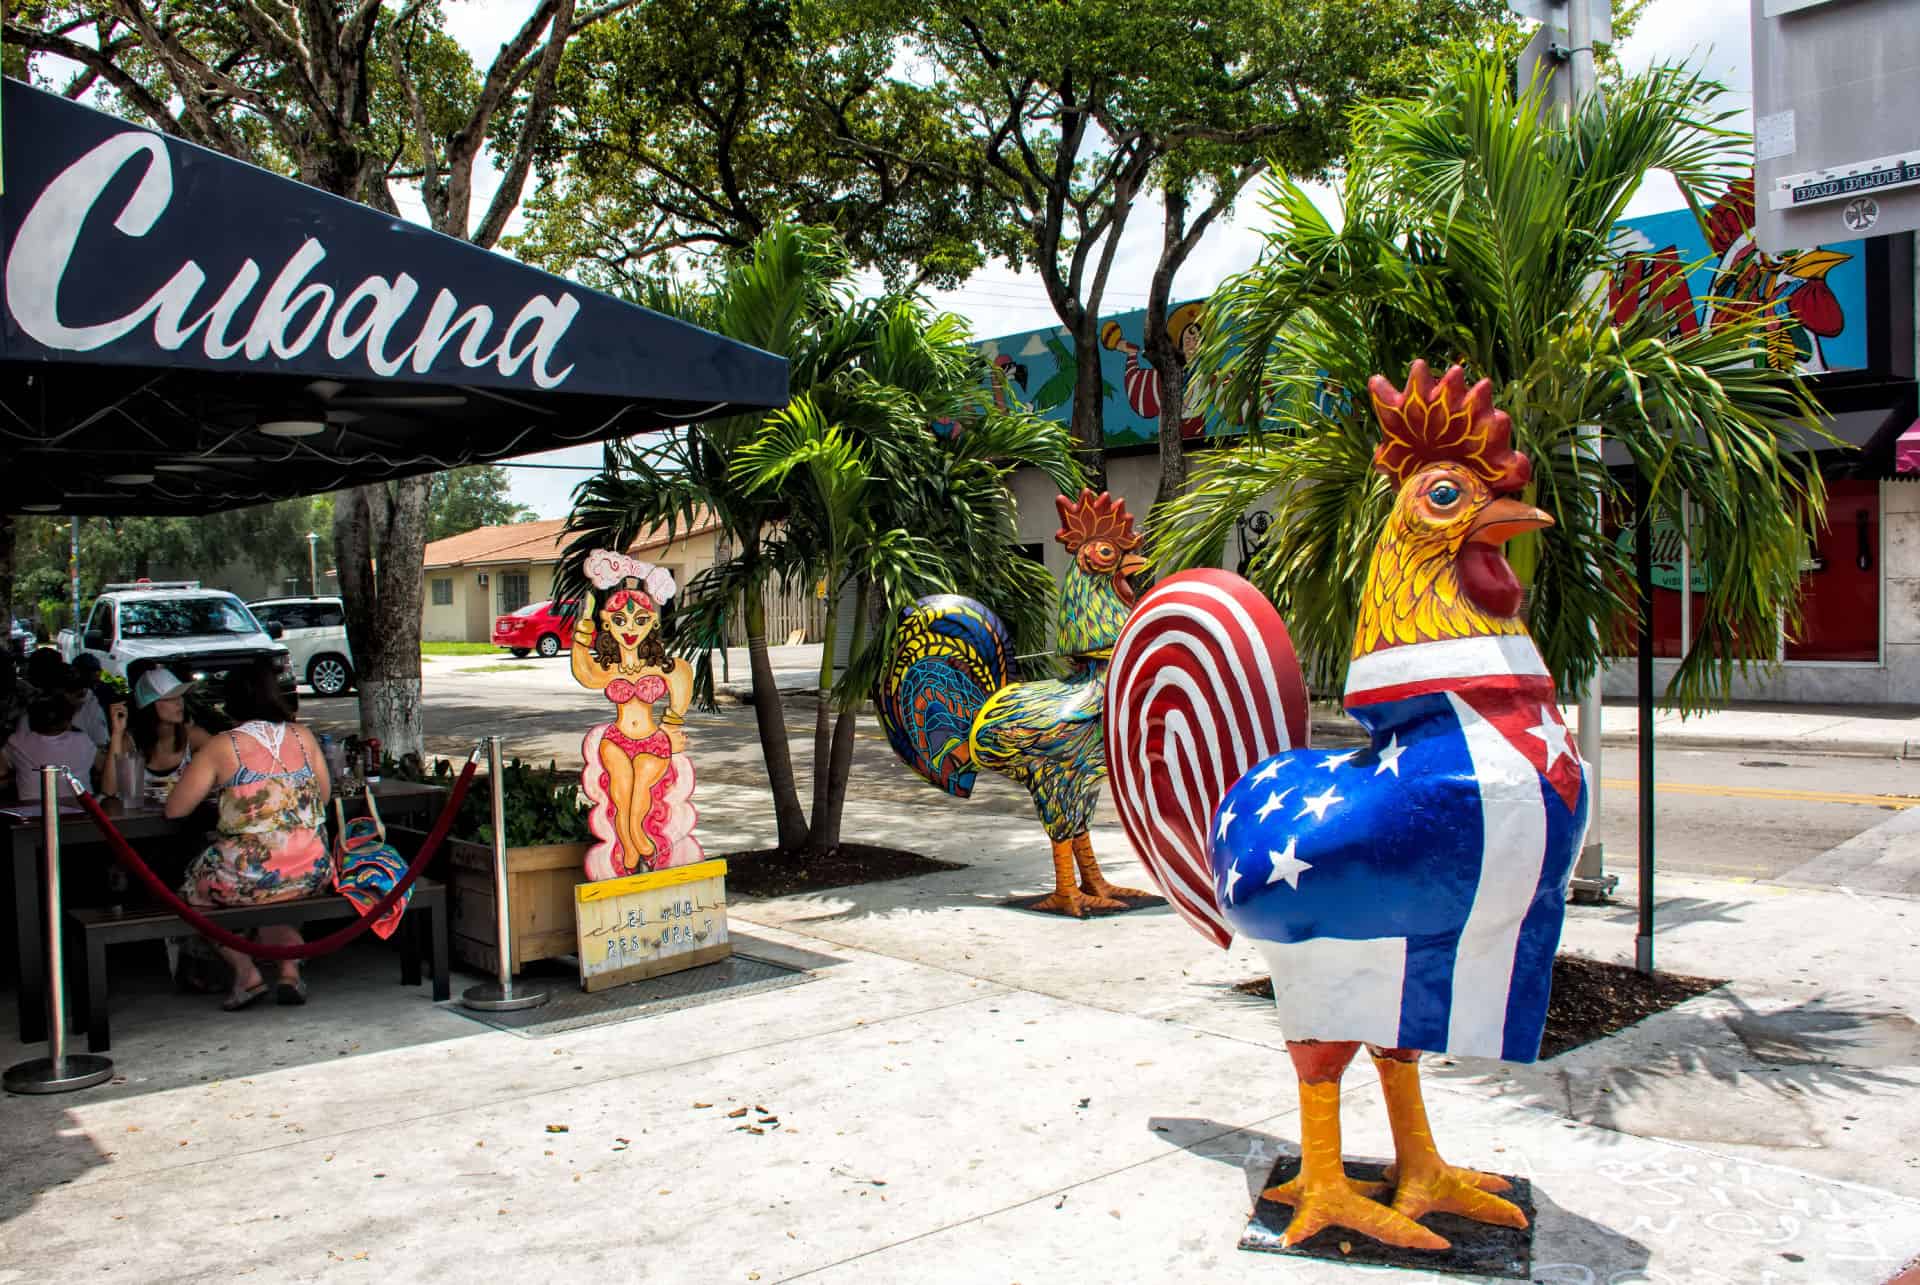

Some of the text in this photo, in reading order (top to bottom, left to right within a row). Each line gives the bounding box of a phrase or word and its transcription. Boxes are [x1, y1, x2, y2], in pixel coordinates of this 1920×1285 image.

[1796, 182, 1838, 200] BAD
[1844, 170, 1902, 191] BLUE
[6, 131, 580, 390] Cubana
[628, 909, 648, 928] EL
[608, 918, 713, 954] RESURAT
